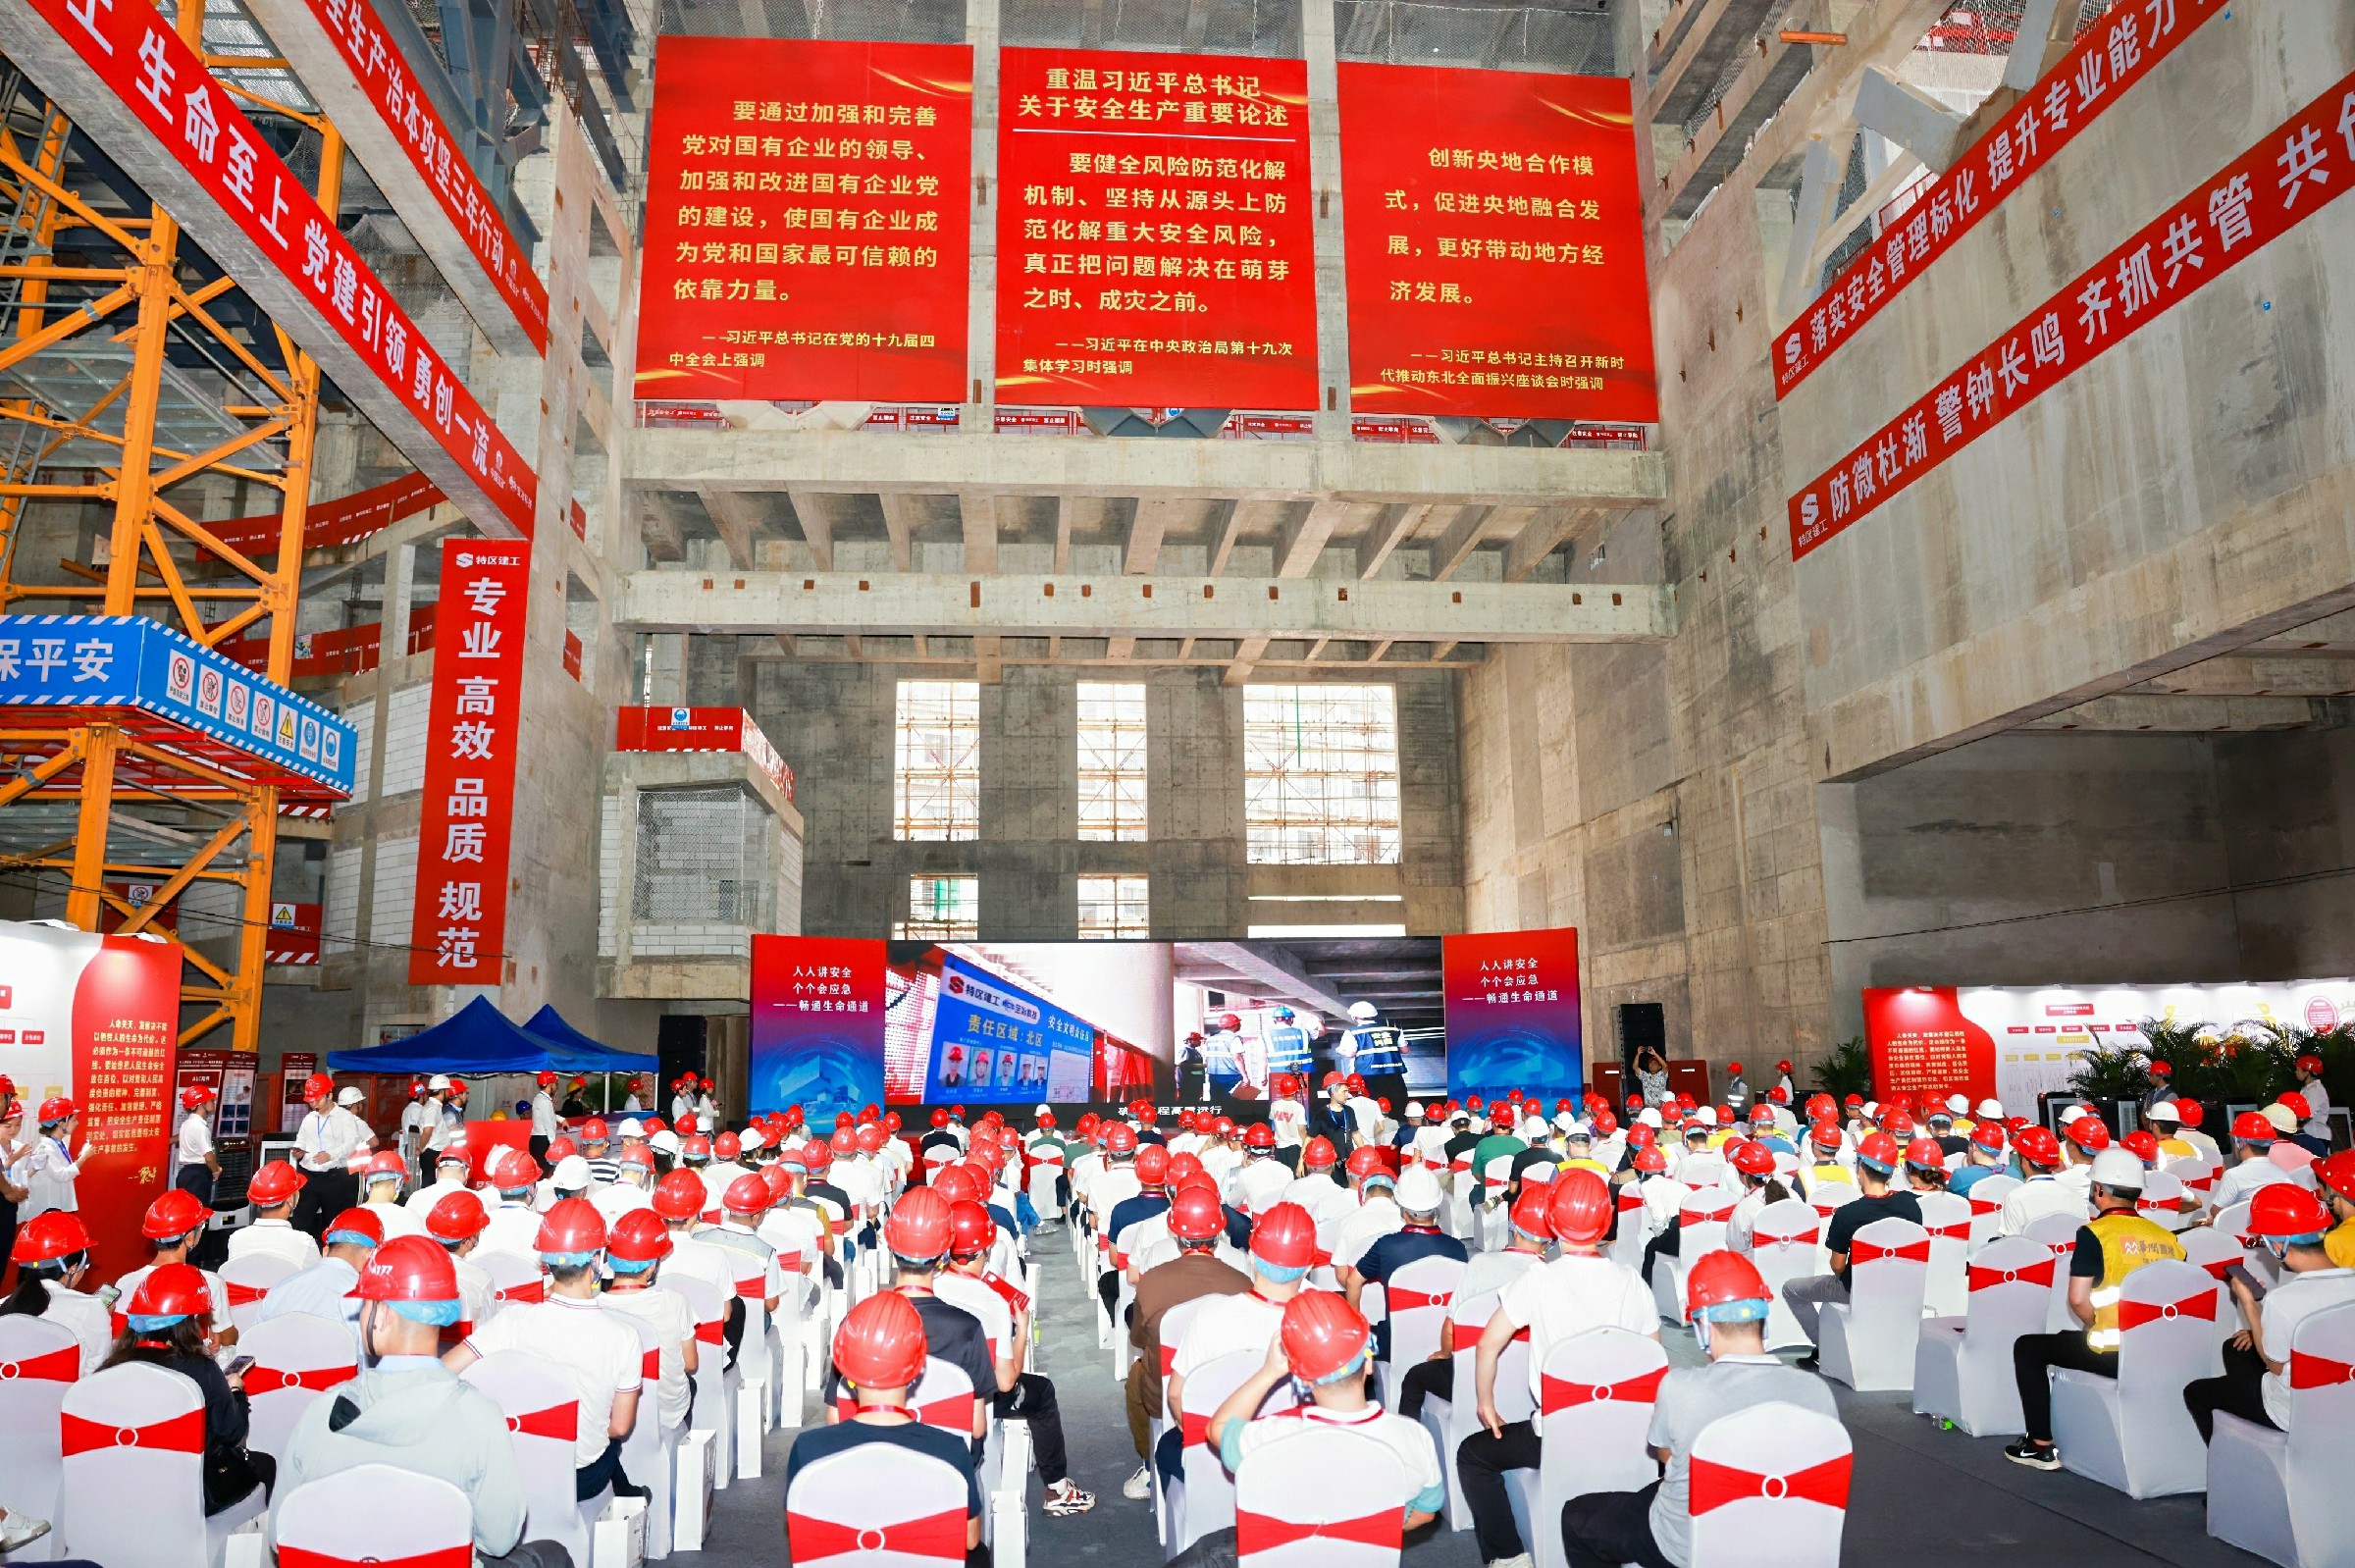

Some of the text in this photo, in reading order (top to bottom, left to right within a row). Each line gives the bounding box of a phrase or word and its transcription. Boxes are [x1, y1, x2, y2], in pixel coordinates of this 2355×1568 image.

[1046, 68, 1260, 97] 重温习近平总书记
[733, 100, 937, 128] 要通过加强和完善
[1018, 94, 1289, 127] 关于安全生产重要论述
[318, 0, 503, 277] 全生产治本攻坚三年行动
[682, 134, 926, 162] 党对国有企业的领导、
[1069, 152, 1286, 181] 要健全风险防范化解
[1428, 147, 1595, 177] 创新央地合作模
[679, 170, 938, 197] 加强和改进国有企业党
[1809, 0, 2176, 354] 落实安全管理标化 提升专业能力
[1023, 185, 1287, 214] 机制、坚持从源头上防
[1385, 189, 1600, 221] 式，促进央地融合发
[677, 206, 938, 233] 的建设，使国有企业成
[1023, 219, 1276, 248] 范化解重大安全风险，
[135, 26, 288, 250] 生命至上
[302, 219, 407, 381] 党建引领
[413, 346, 489, 476] 勇创一流
[675, 241, 938, 269] 为党和国家最可信赖的
[1387, 235, 1604, 265] 展，更好带动地方经
[1023, 253, 1289, 282] 真正把问题解决在萌芽
[673, 278, 791, 301] 依靠力量。
[1022, 287, 1210, 314] 之时、成灾之前。
[1389, 281, 1474, 304] 济发展。
[669, 351, 765, 368] 中全会上强调
[1829, 409, 1928, 521] 防微杜渐
[1935, 311, 2066, 444] 警钟长鸣
[2076, 172, 2253, 345] 齐抓共管
[1022, 359, 1133, 375] 集体学习时强调
[1380, 368, 1604, 391] 代推动东北全面振兴座谈会时强调
[1781, 353, 1809, 386] 特区建工
[1798, 518, 1829, 548] 特区建工
[475, 554, 520, 566] 特区建工
[793, 966, 853, 978] 人人讲安全
[1479, 957, 1539, 971] 人人讲安全
[793, 982, 852, 996] 个个会应急
[1480, 973, 1540, 987] 个个会应急
[966, 984, 1000, 1007] 特区建工
